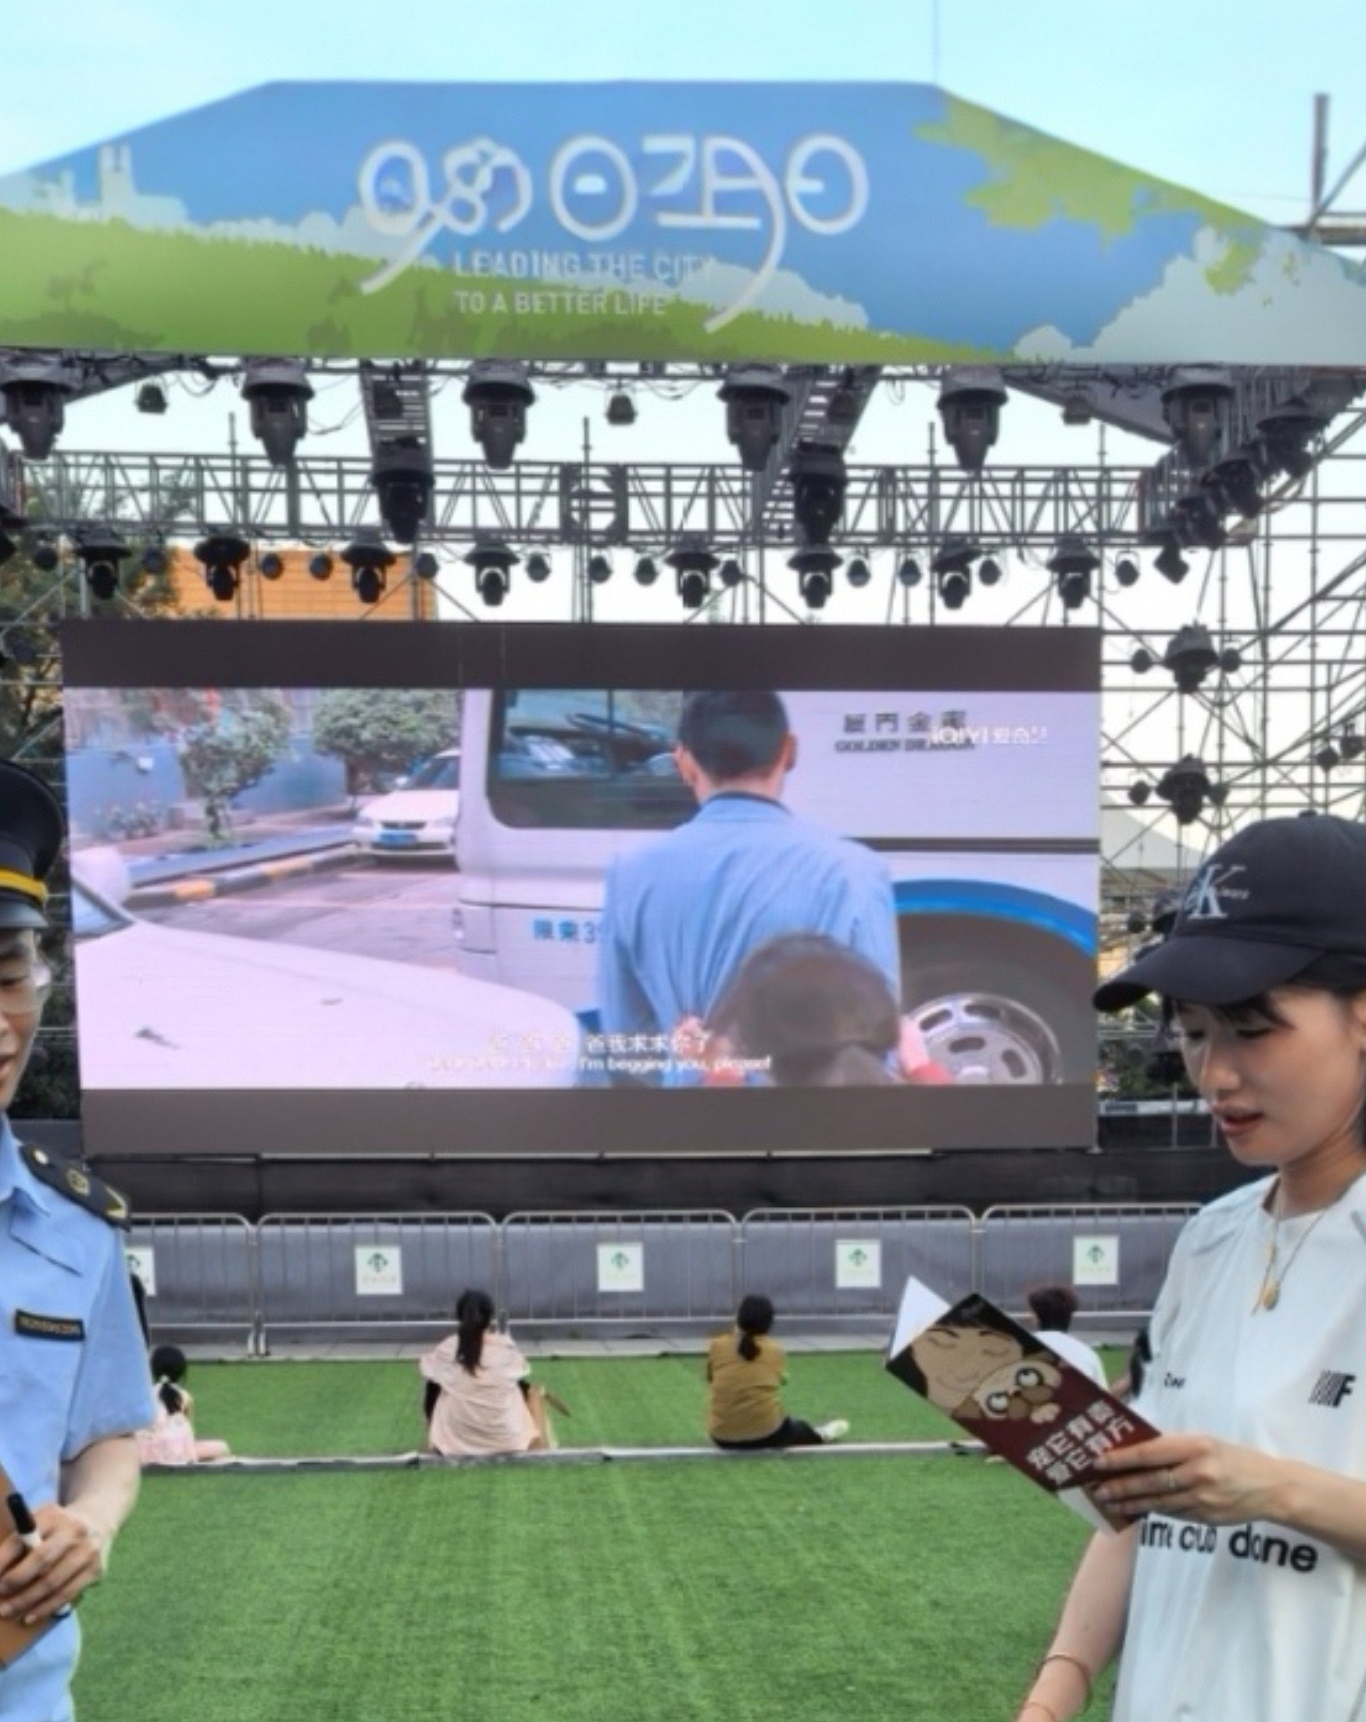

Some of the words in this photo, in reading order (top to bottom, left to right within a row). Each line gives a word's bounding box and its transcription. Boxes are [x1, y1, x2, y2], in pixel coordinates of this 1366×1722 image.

[453, 250, 581, 279] LEADING
[586, 251, 645, 279] THE
[653, 252, 715, 281] CITY
[454, 290, 485, 315] TO
[491, 291, 509, 315] A
[514, 291, 608, 316] BETTER
[614, 292, 668, 316] LIFE
